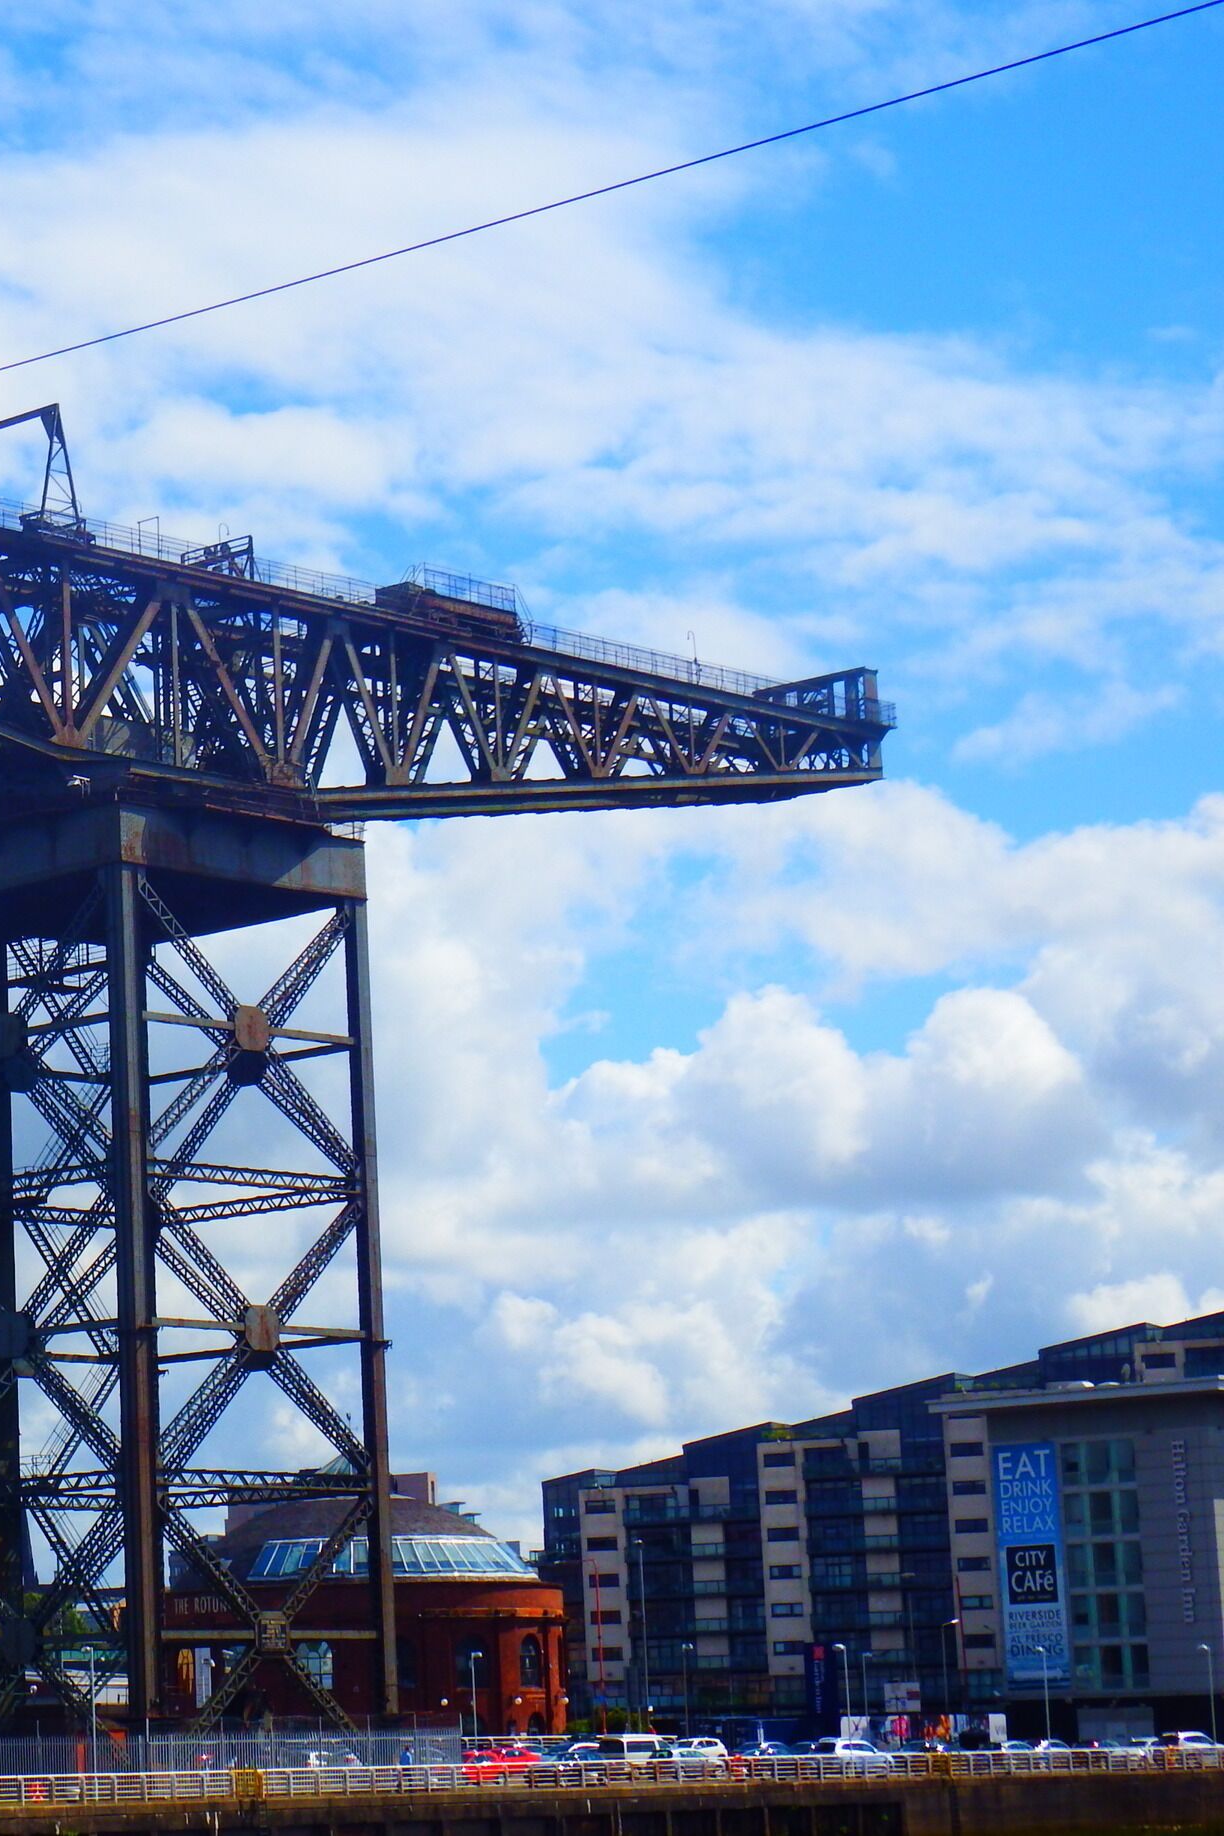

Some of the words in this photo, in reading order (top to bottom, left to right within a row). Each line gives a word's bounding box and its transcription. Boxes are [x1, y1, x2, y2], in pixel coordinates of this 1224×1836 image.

[997, 1449, 1050, 1480] EAT
[1171, 1440, 1187, 1504] Hilton
[999, 1479, 1053, 1498] DRINK
[1000, 1497, 1053, 1516] ENJOY
[1002, 1514, 1055, 1533] RELAX
[1178, 1509, 1193, 1581] Garden
[1015, 1550, 1047, 1567] CITY
[175, 1598, 189, 1615] THE
[1008, 1609, 1062, 1621] RIVERSIDE
[1183, 1588, 1196, 1623] Inn
